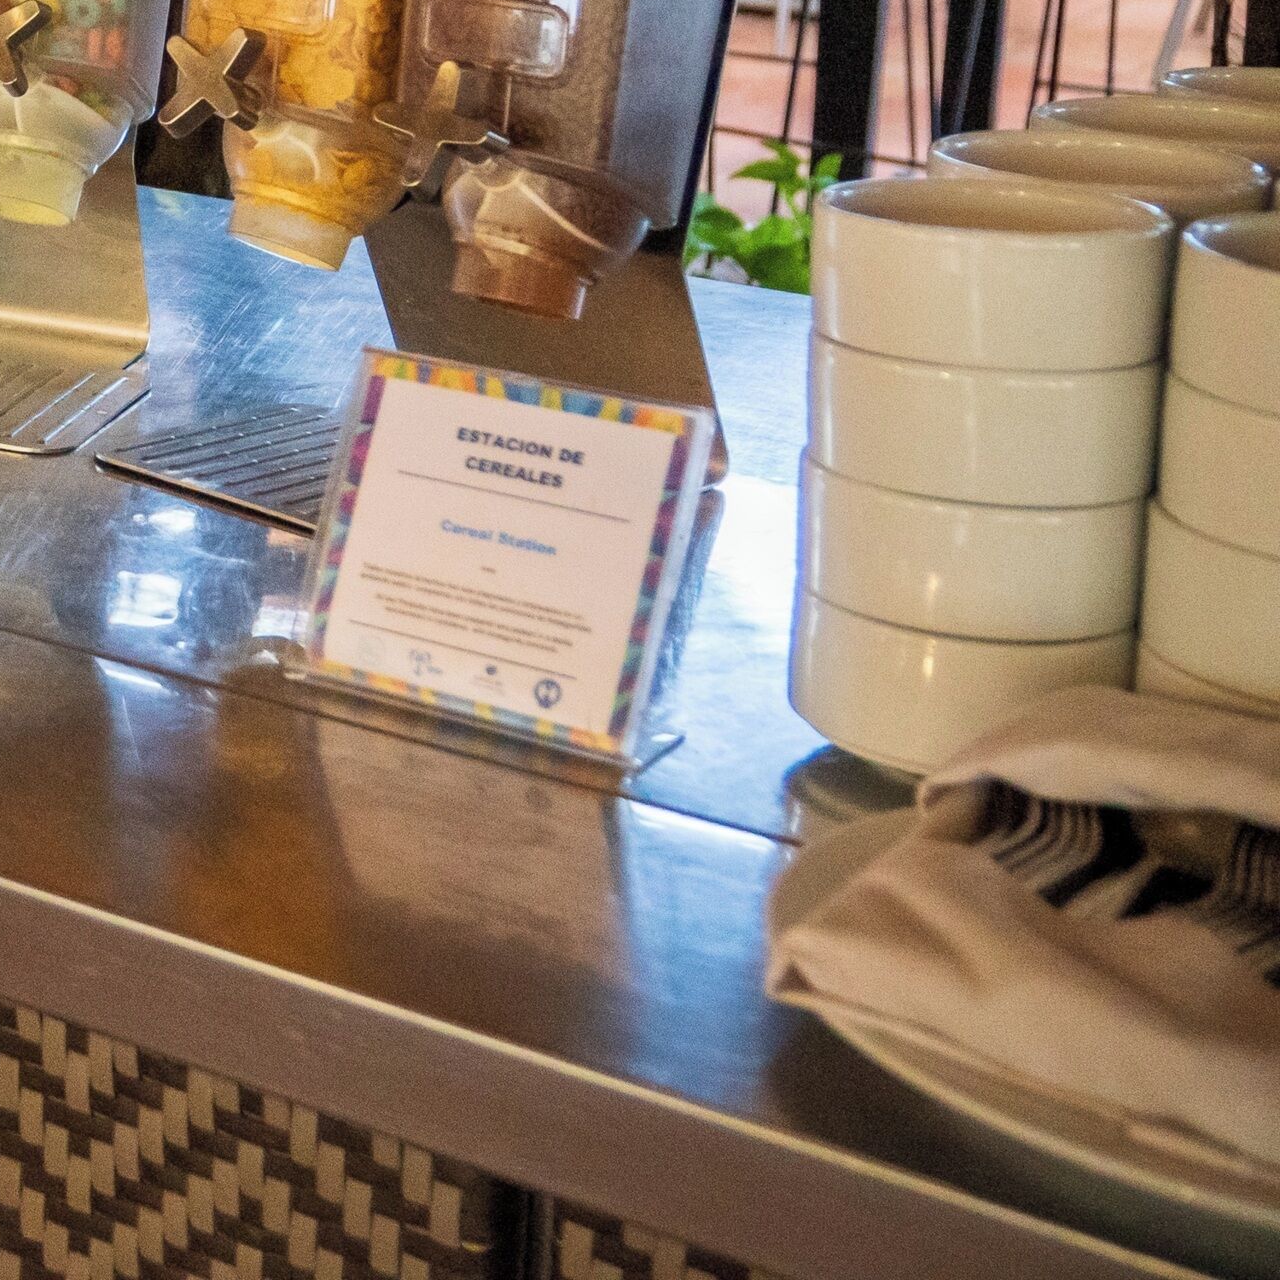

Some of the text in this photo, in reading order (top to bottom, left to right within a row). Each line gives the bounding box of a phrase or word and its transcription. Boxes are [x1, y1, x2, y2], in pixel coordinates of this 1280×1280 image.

[456, 426, 585, 465] ESTACION DE
[465, 456, 564, 488] CEREALES
[442, 519, 557, 556] Cereal Station
